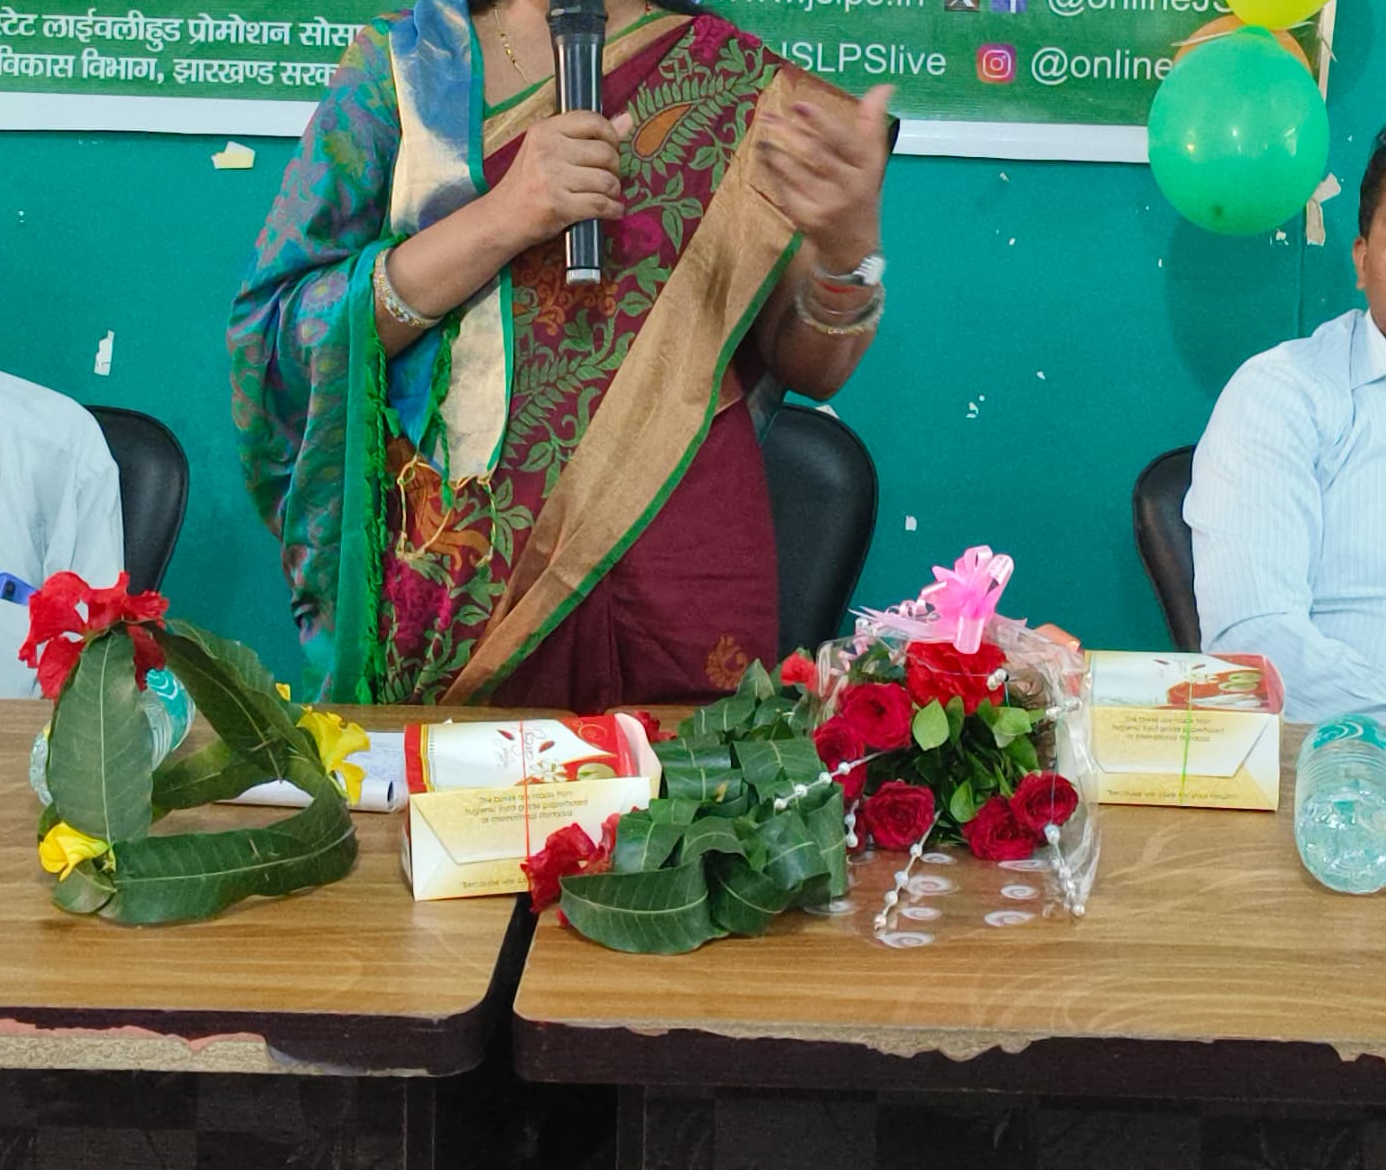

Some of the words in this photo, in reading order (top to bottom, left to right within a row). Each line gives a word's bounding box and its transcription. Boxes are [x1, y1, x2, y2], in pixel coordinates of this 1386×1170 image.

[42, 8, 184, 52] लाईवलीहुड
[187, 13, 293, 46] प्रोमोशन
[81, 47, 165, 84] विभाग,
[172, 58, 277, 85] झारखण्ड
[280, 61, 341, 87] सरक
[1031, 47, 1174, 85] @online
